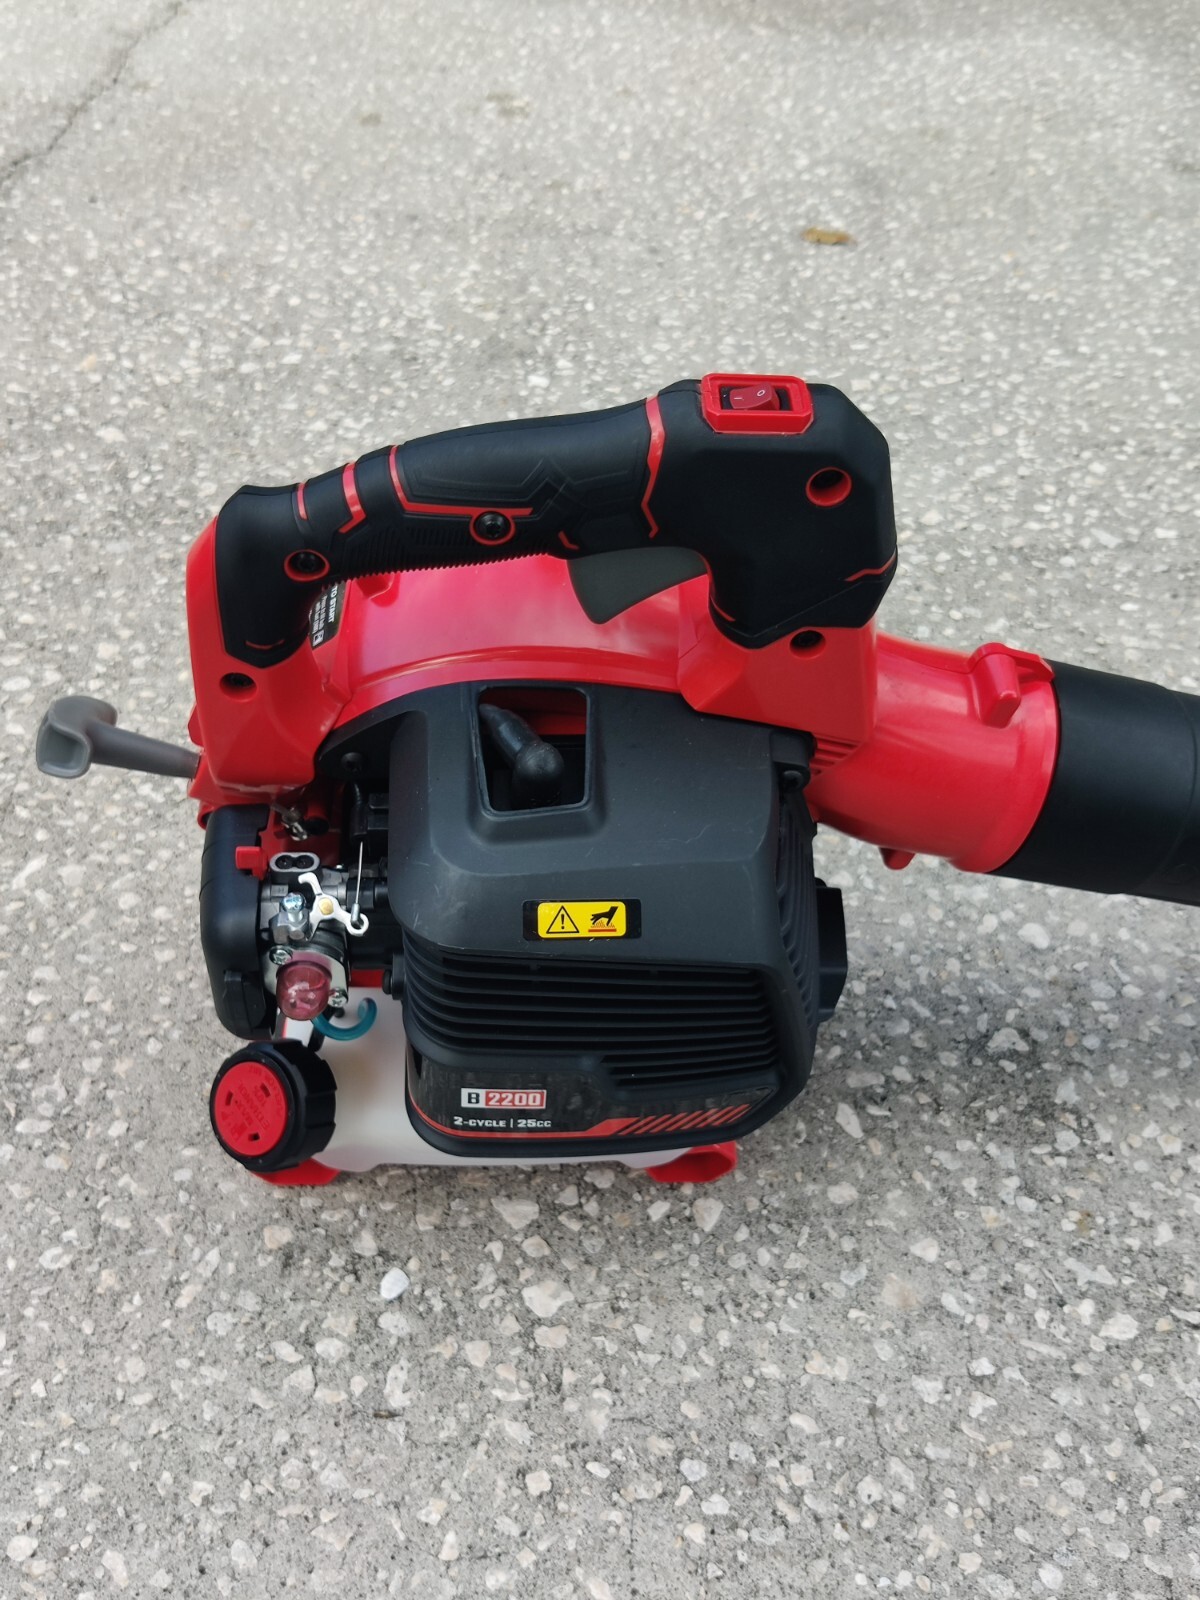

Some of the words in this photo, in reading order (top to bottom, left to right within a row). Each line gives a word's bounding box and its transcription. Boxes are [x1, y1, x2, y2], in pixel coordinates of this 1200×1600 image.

[328, 597, 337, 623] START
[467, 1092, 480, 1104] B
[488, 1092, 541, 1106] 2200
[453, 1116, 507, 1128] 2-CYCLE
